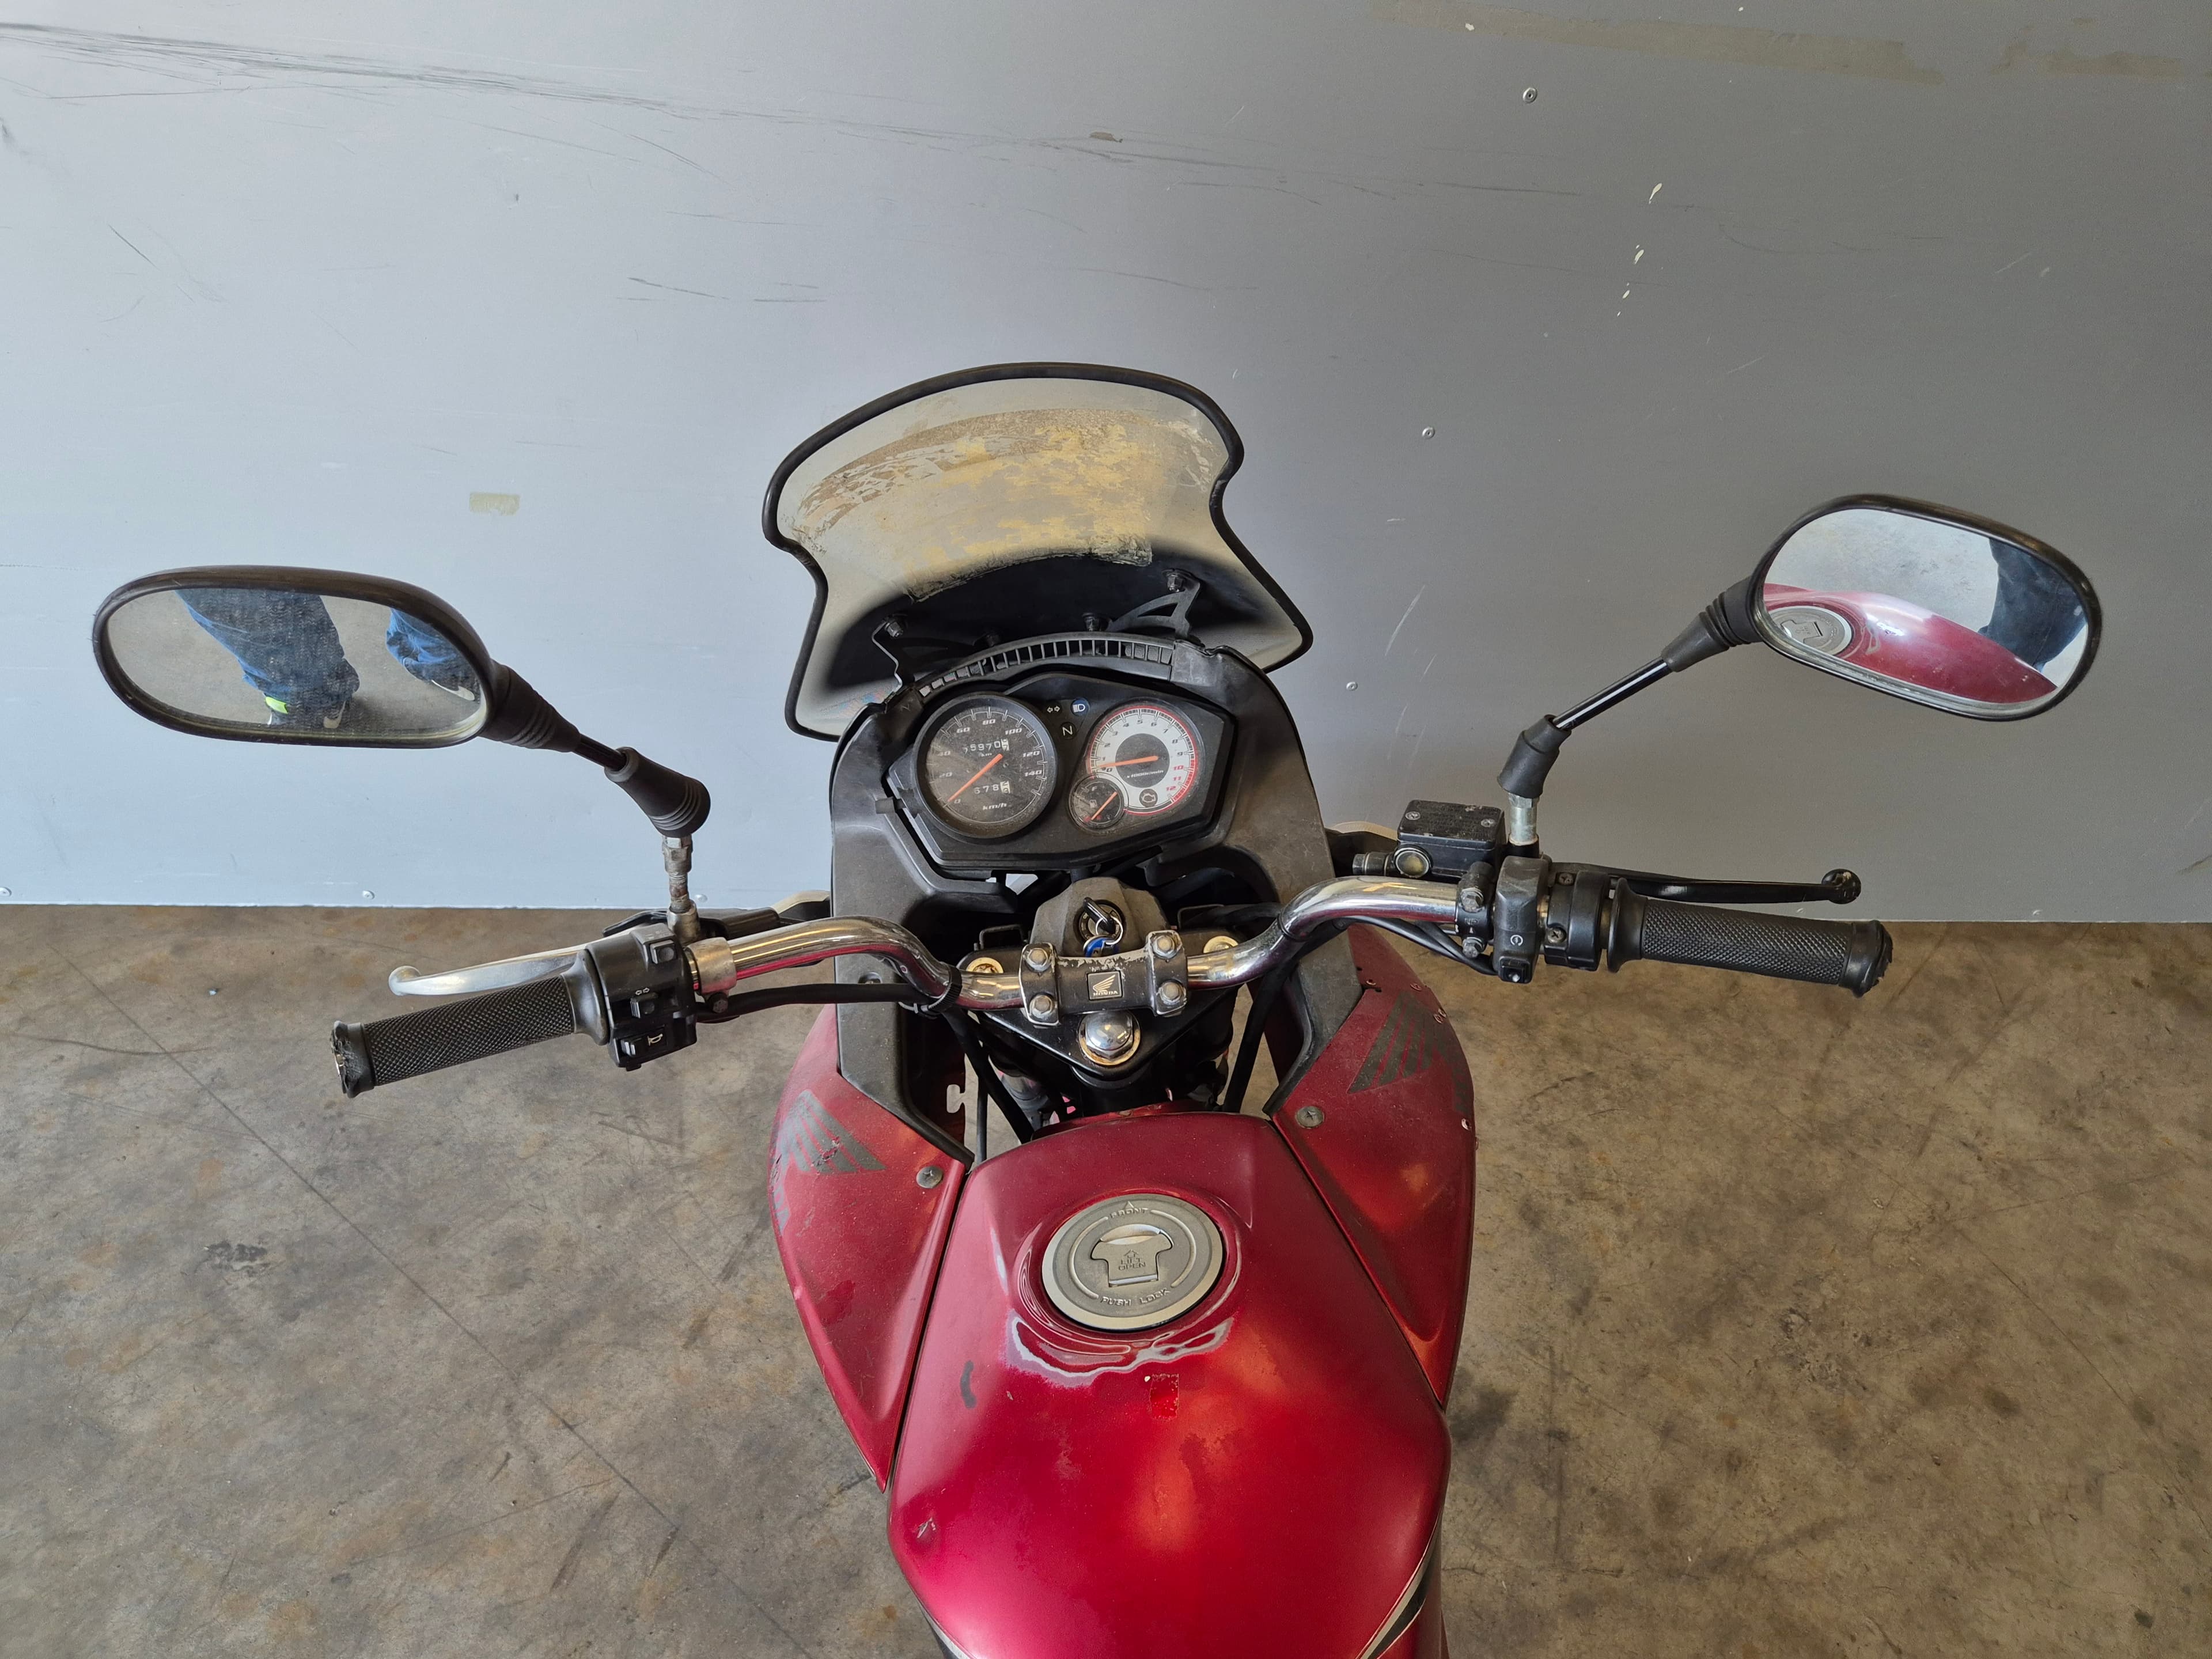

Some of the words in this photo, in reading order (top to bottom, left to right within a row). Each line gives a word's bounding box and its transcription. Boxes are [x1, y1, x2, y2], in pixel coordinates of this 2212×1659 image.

[1062, 725, 1073, 736] N
[982, 802, 1007, 810] km/h
[1109, 1207, 1149, 1218] FRONT
[1118, 1262, 1146, 1271] OPEN
[1101, 1296, 1131, 1306] PUSH
[1140, 1287, 1171, 1304] LOCK
